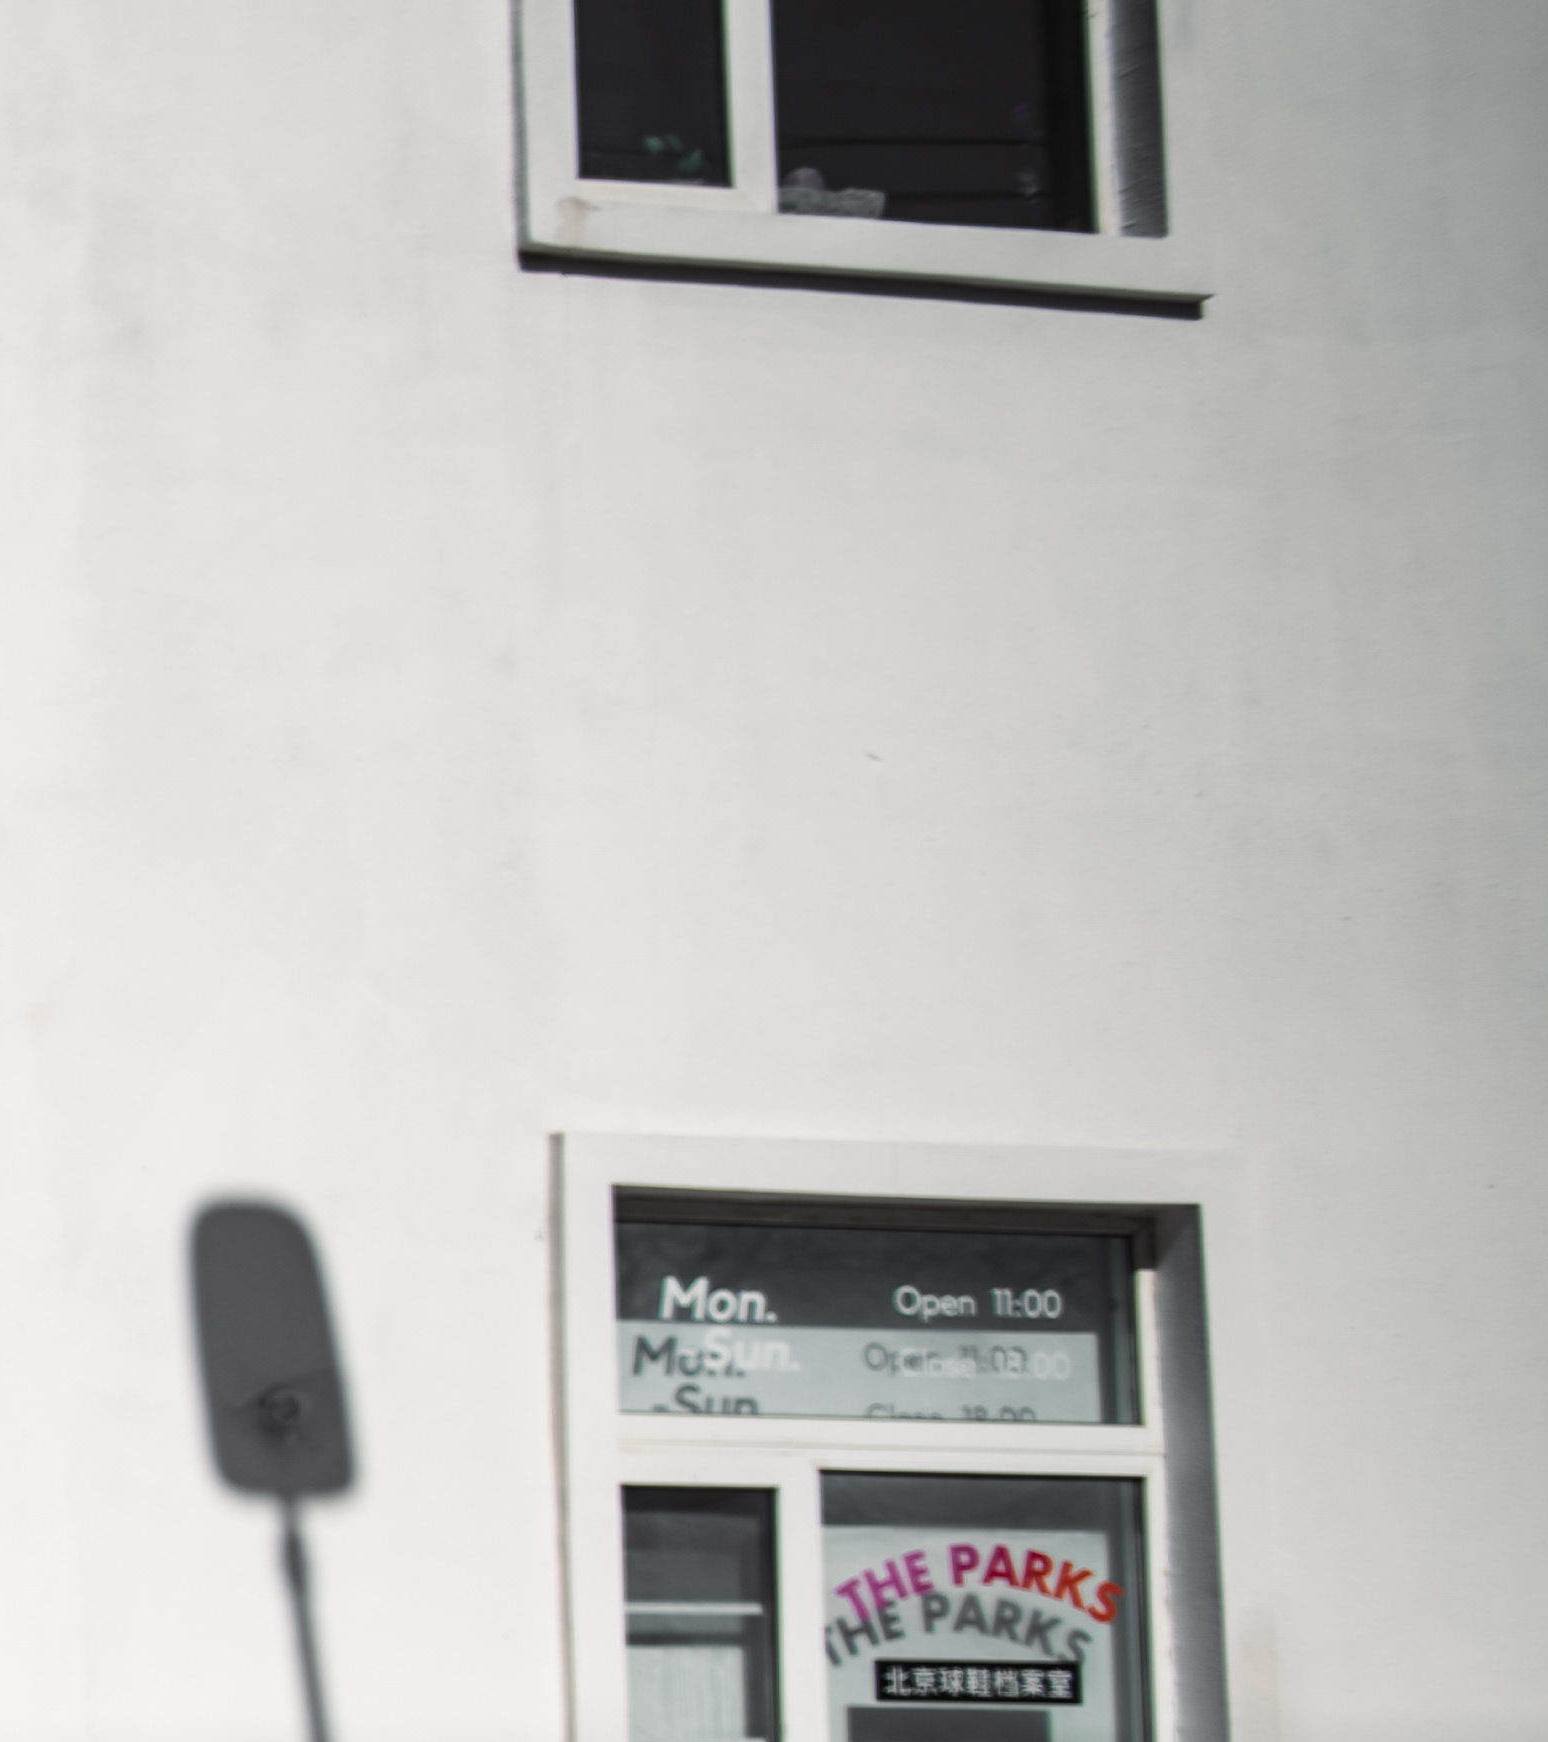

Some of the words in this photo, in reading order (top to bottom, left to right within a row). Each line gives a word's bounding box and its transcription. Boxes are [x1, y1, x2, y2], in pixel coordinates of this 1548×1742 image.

[659, 1275, 777, 1323] Mon.
[892, 1284, 977, 1323] Open
[990, 1286, 1065, 1319] 11:00
[832, 1547, 936, 1621] THE
[946, 1542, 1125, 1624] PARKS
[885, 1666, 1072, 1698] 北京球鞋档案室
